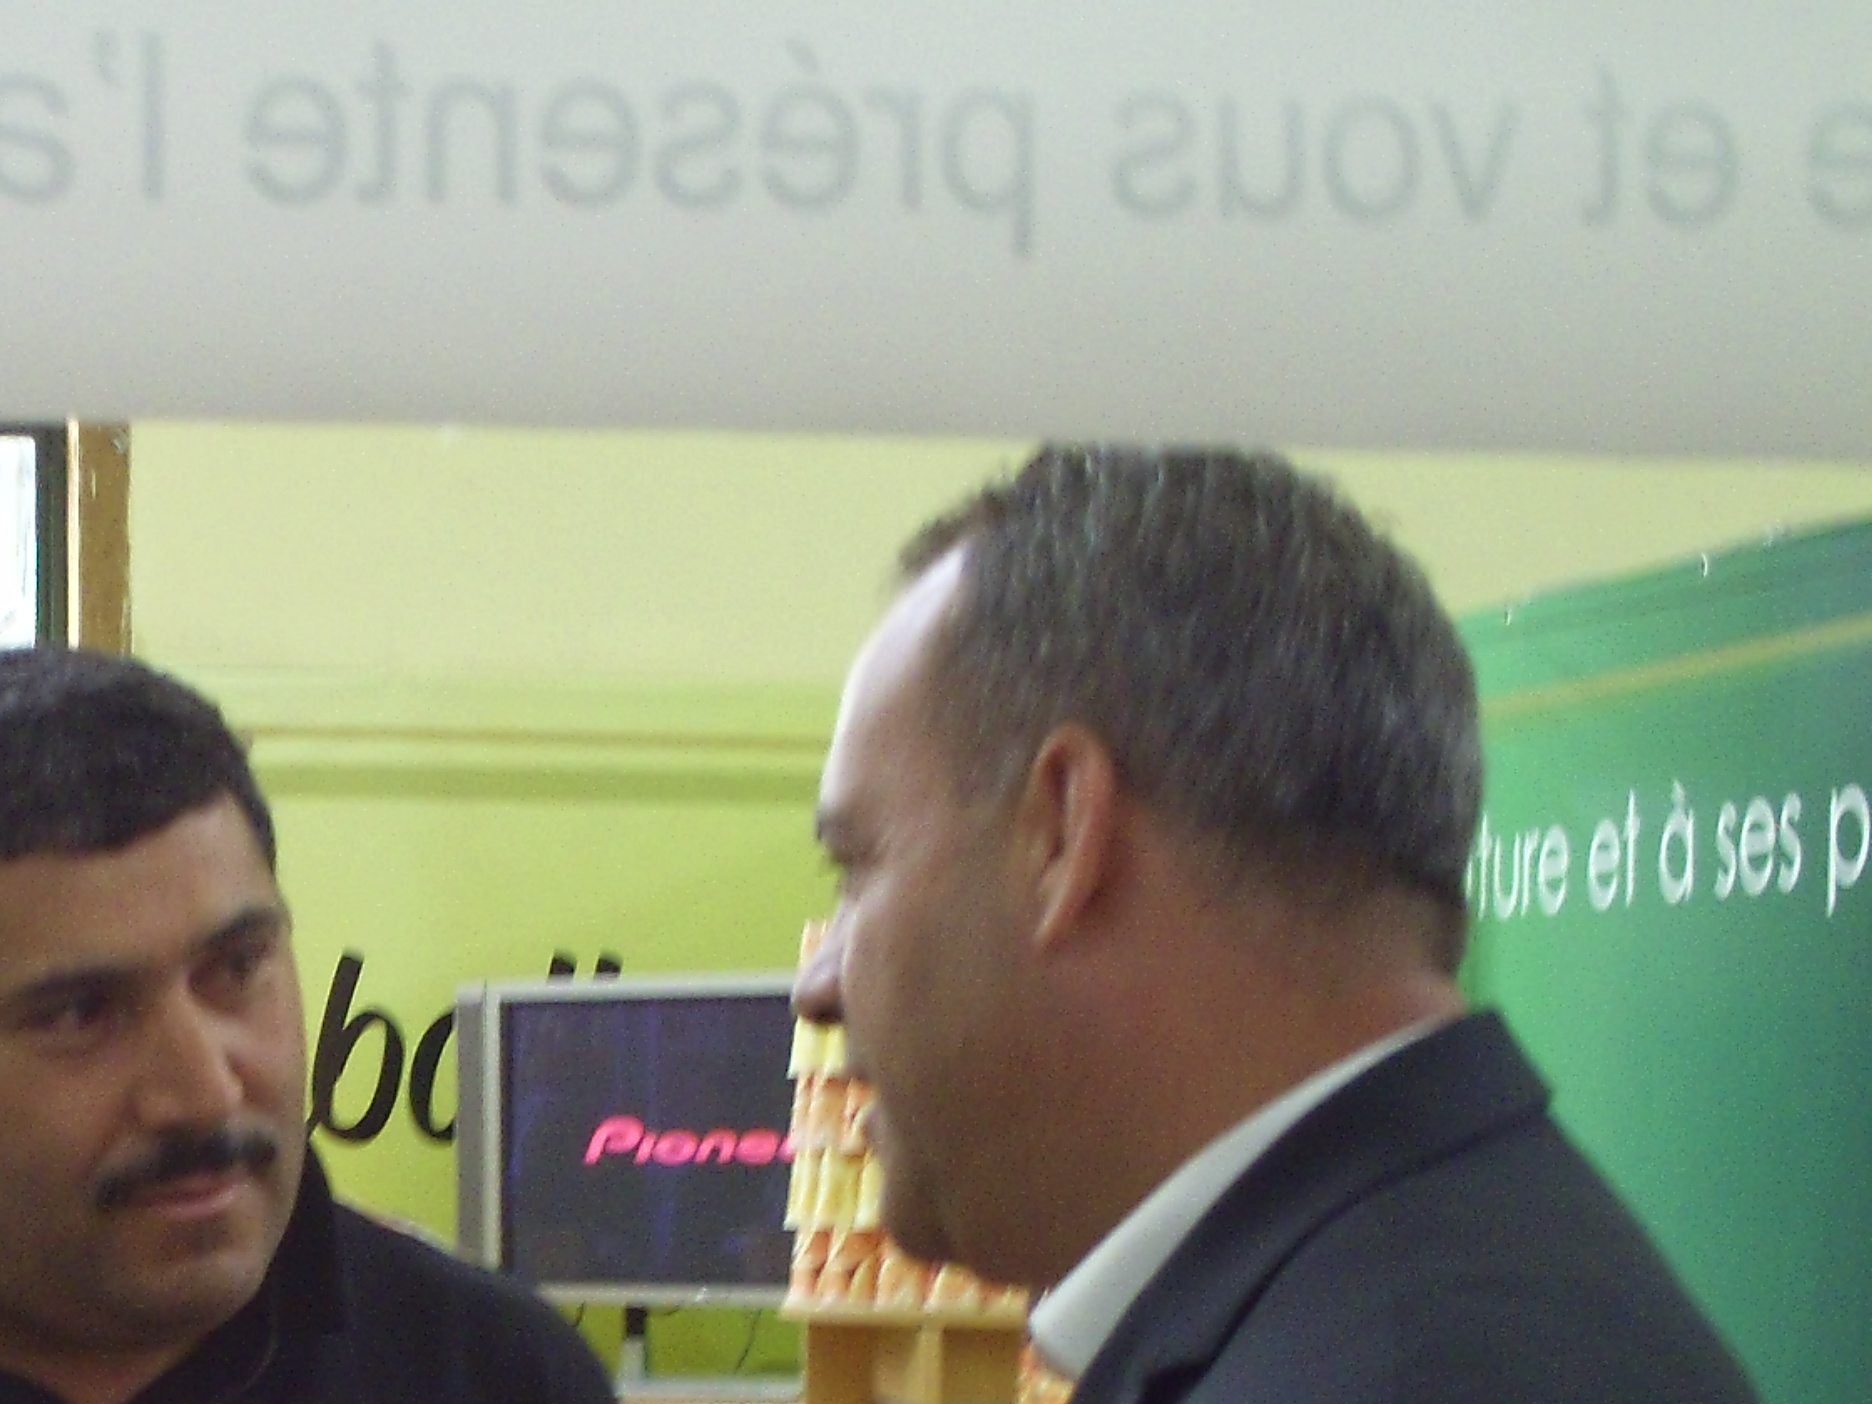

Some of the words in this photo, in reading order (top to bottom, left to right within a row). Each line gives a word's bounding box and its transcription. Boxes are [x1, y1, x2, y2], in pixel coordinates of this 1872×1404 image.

[1466, 808, 1569, 922] ture
[1586, 786, 1641, 913] et
[1658, 777, 1695, 905] à
[1713, 791, 1803, 901] ses
